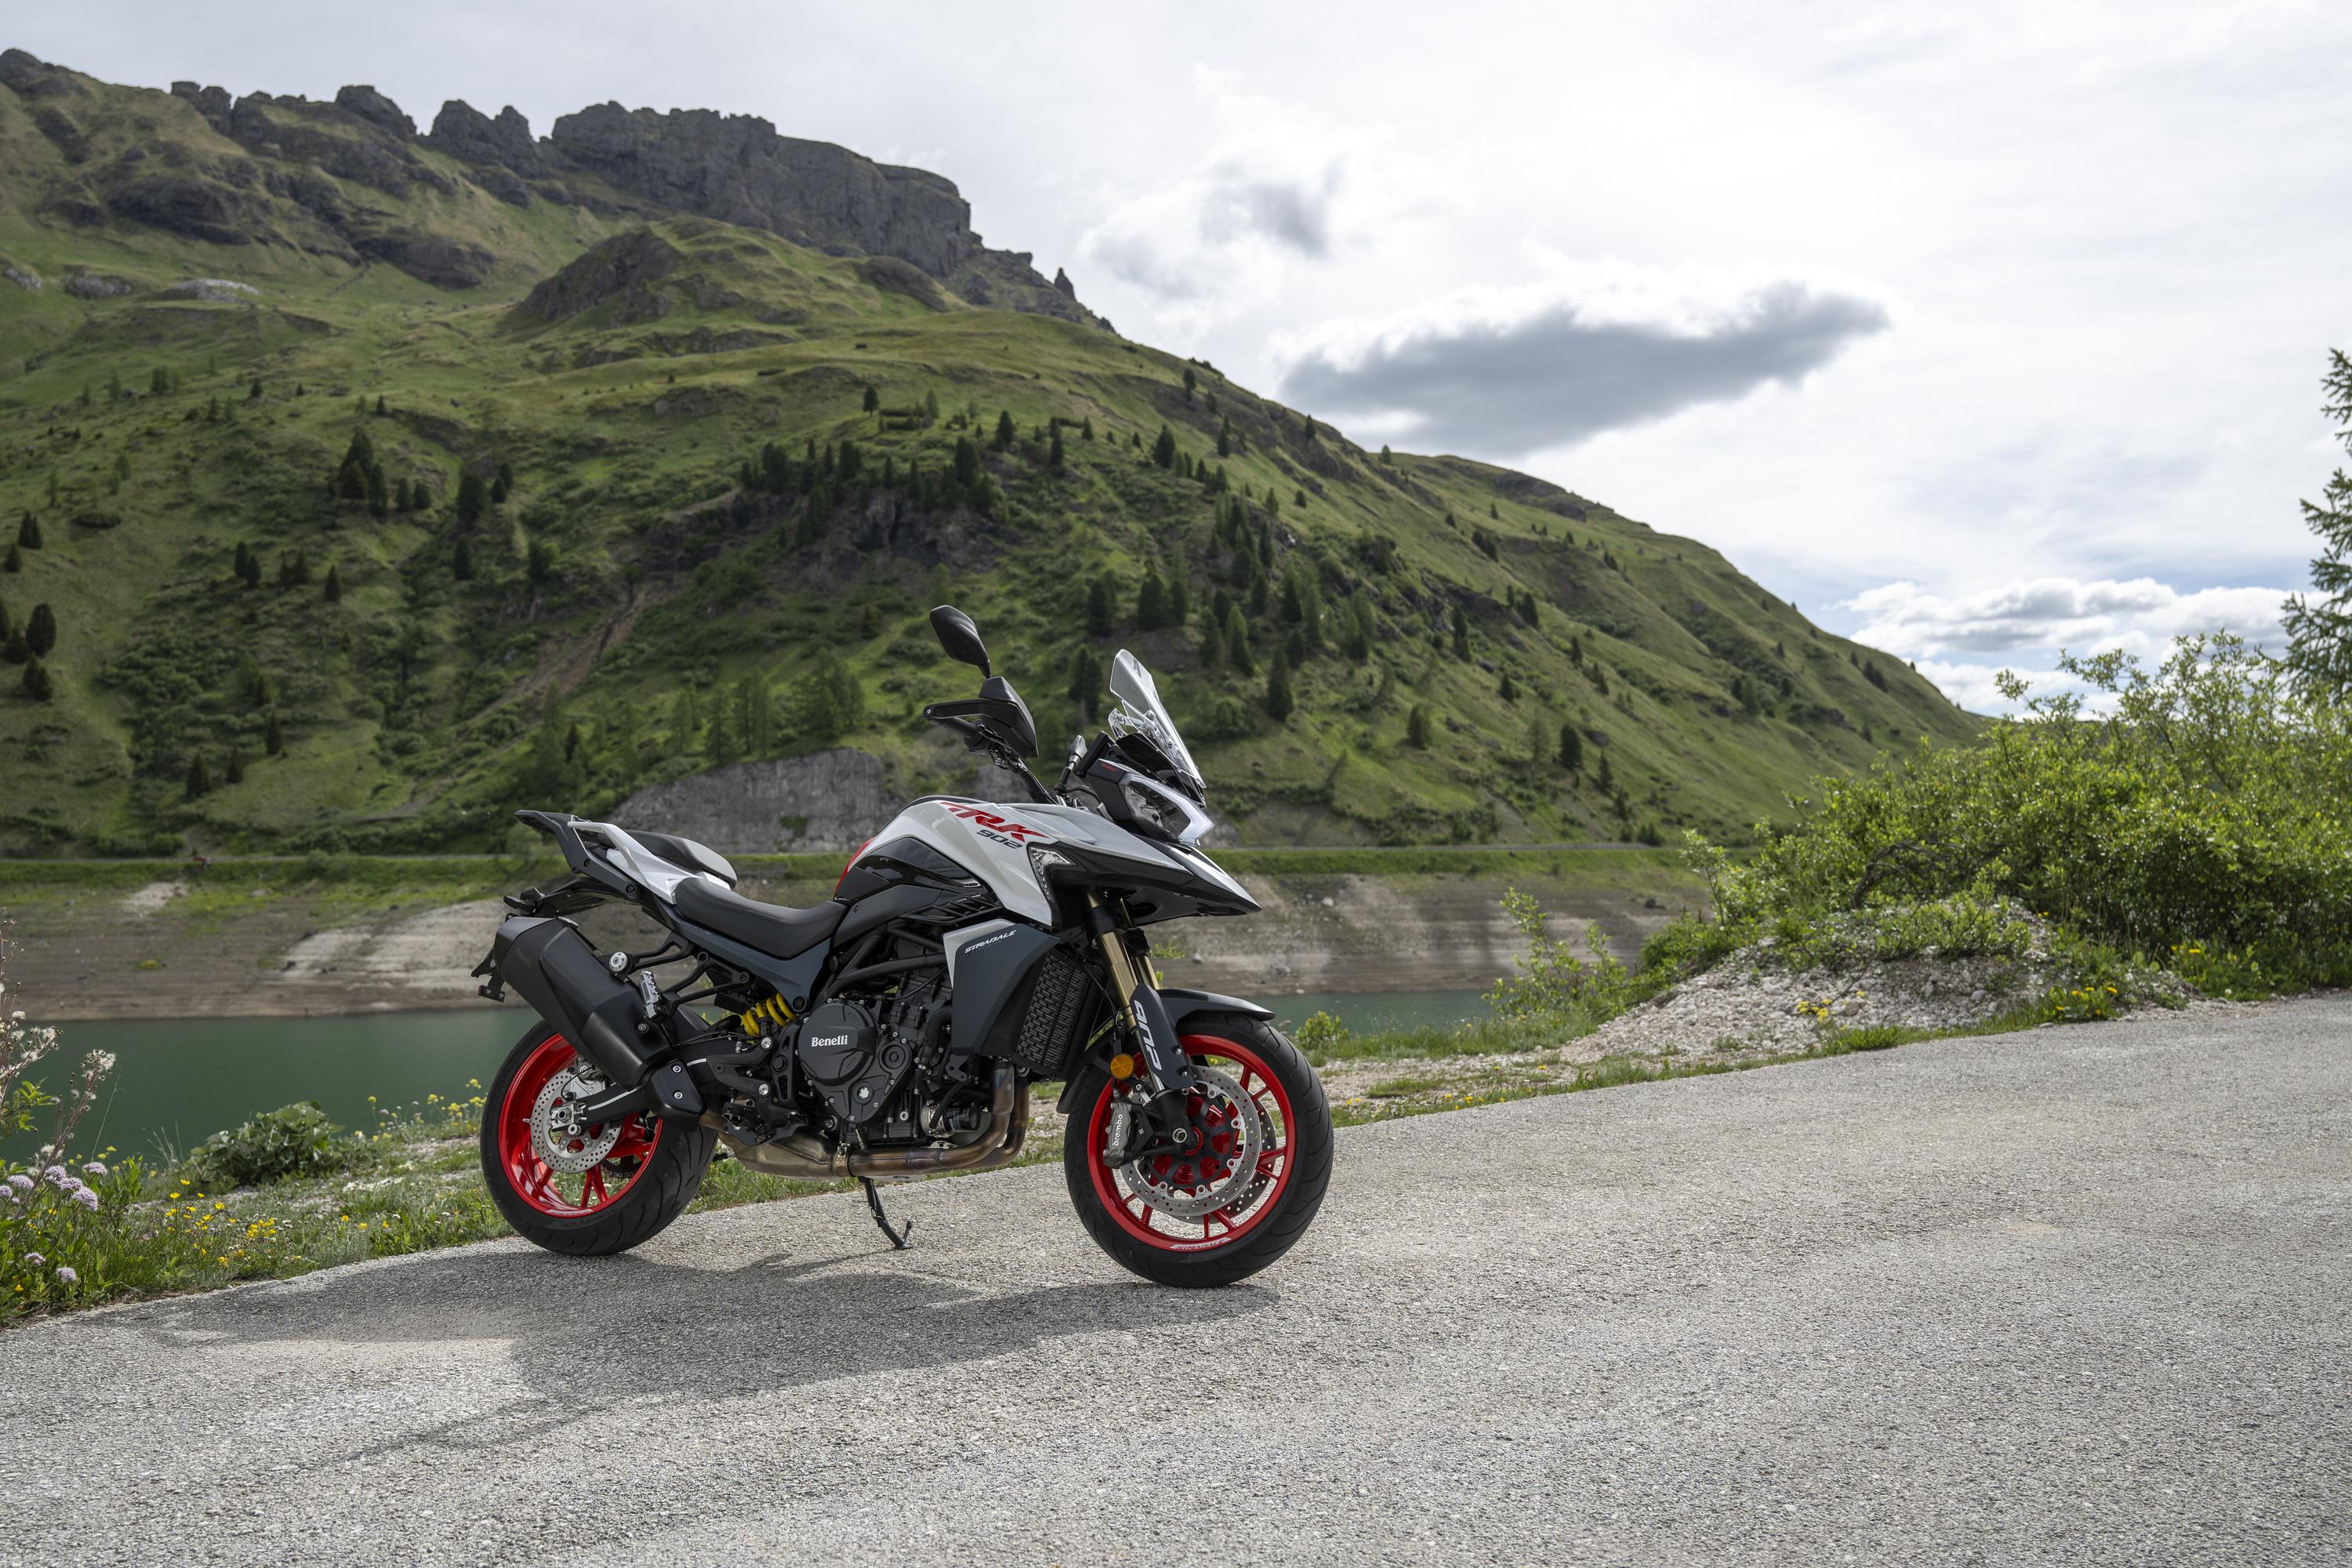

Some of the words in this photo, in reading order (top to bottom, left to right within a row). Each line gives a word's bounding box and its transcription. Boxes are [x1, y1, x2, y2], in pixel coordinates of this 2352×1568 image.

[940, 801, 1050, 843] TRK
[977, 829, 1023, 849] 902
[964, 929, 1017, 954] STRADALE
[811, 1034, 848, 1047] Benelli
[1112, 1114, 1123, 1146] brembo
